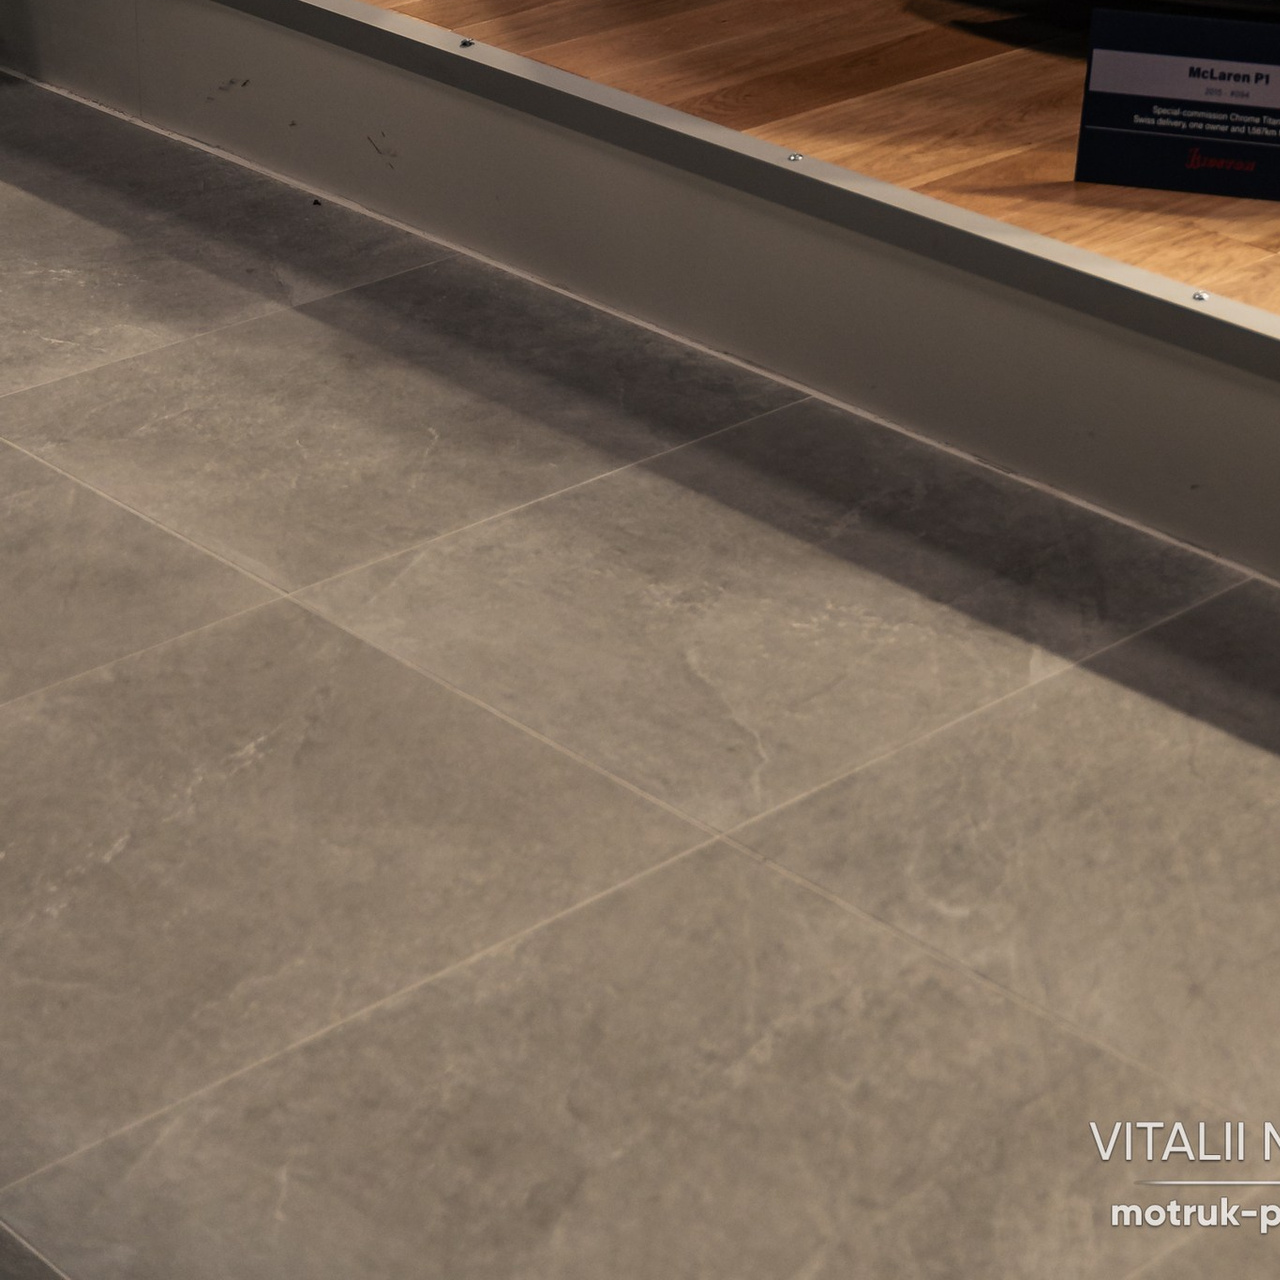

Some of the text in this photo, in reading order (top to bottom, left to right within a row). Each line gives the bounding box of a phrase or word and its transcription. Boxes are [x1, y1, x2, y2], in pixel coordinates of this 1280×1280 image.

[1188, 65, 1271, 86] McLaren P1
[1133, 114, 1155, 125] Swiss
[1188, 121, 1204, 130] one
[1205, 123, 1229, 132] owner
[1230, 125, 1245, 134] and
[1152, 104, 1228, 121] Special-commission
[1229, 112, 1261, 124] Chrome
